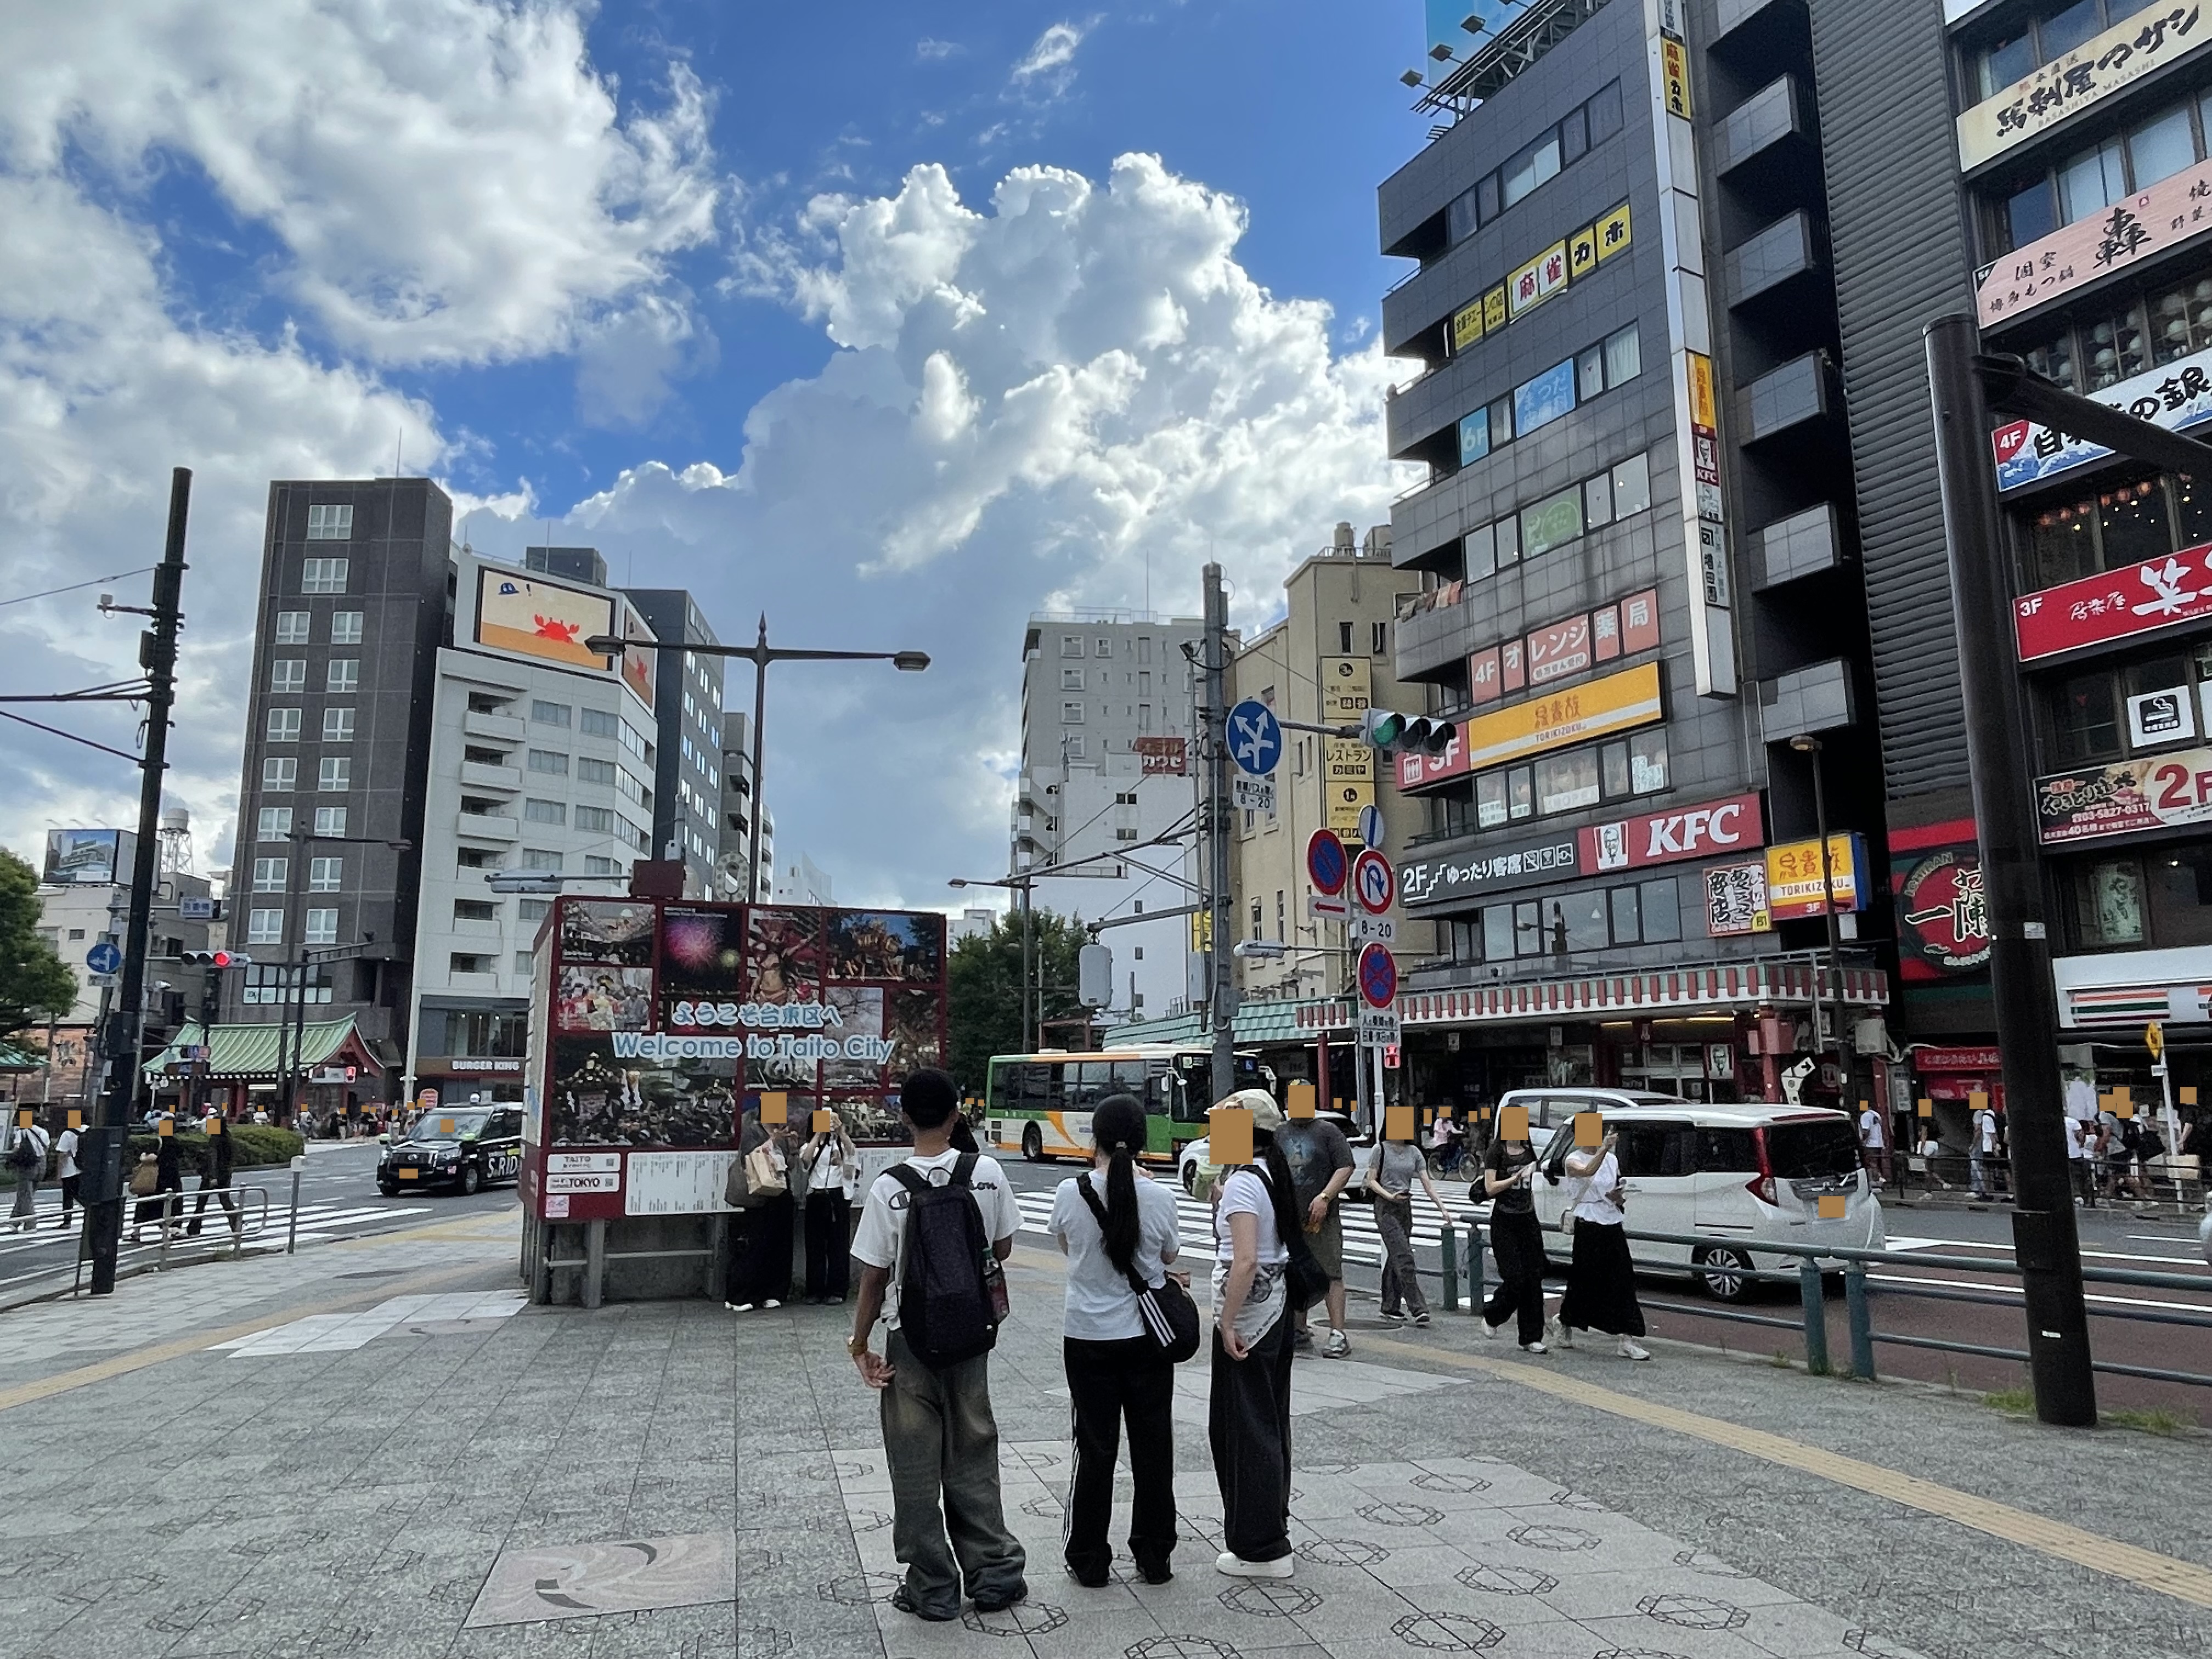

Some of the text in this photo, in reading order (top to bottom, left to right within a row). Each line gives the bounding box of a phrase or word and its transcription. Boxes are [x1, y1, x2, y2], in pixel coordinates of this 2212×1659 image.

[2038, 59, 2156, 128] BASASHIYA MASASHI
[1462, 426, 1487, 453] 6F
[1999, 430, 2021, 449] 4F
[2019, 596, 2042, 617] 3F
[1505, 600, 1649, 669] オレンジ薬局
[1475, 659, 1495, 684] 4F
[1534, 695, 1581, 729] 鳥貴族
[1537, 724, 1582, 743] TORIKIZOKU
[1327, 749, 1371, 762] レストラン
[1646, 804, 1739, 856] KFC
[1403, 865, 1427, 893] 2F
[1780, 878, 1843, 896] TORIKIZKU
[1805, 902, 1820, 913] 3F
[1362, 920, 1391, 938] 8-20
[1757, 915, 1768, 927] B1
[674, 1002, 844, 1027] ようこそ台東区へ
[613, 1034, 895, 1064] Welcome to Taito City
[452, 1060, 521, 1071] BURGER KING
[568, 1178, 600, 1188] TOKYO
